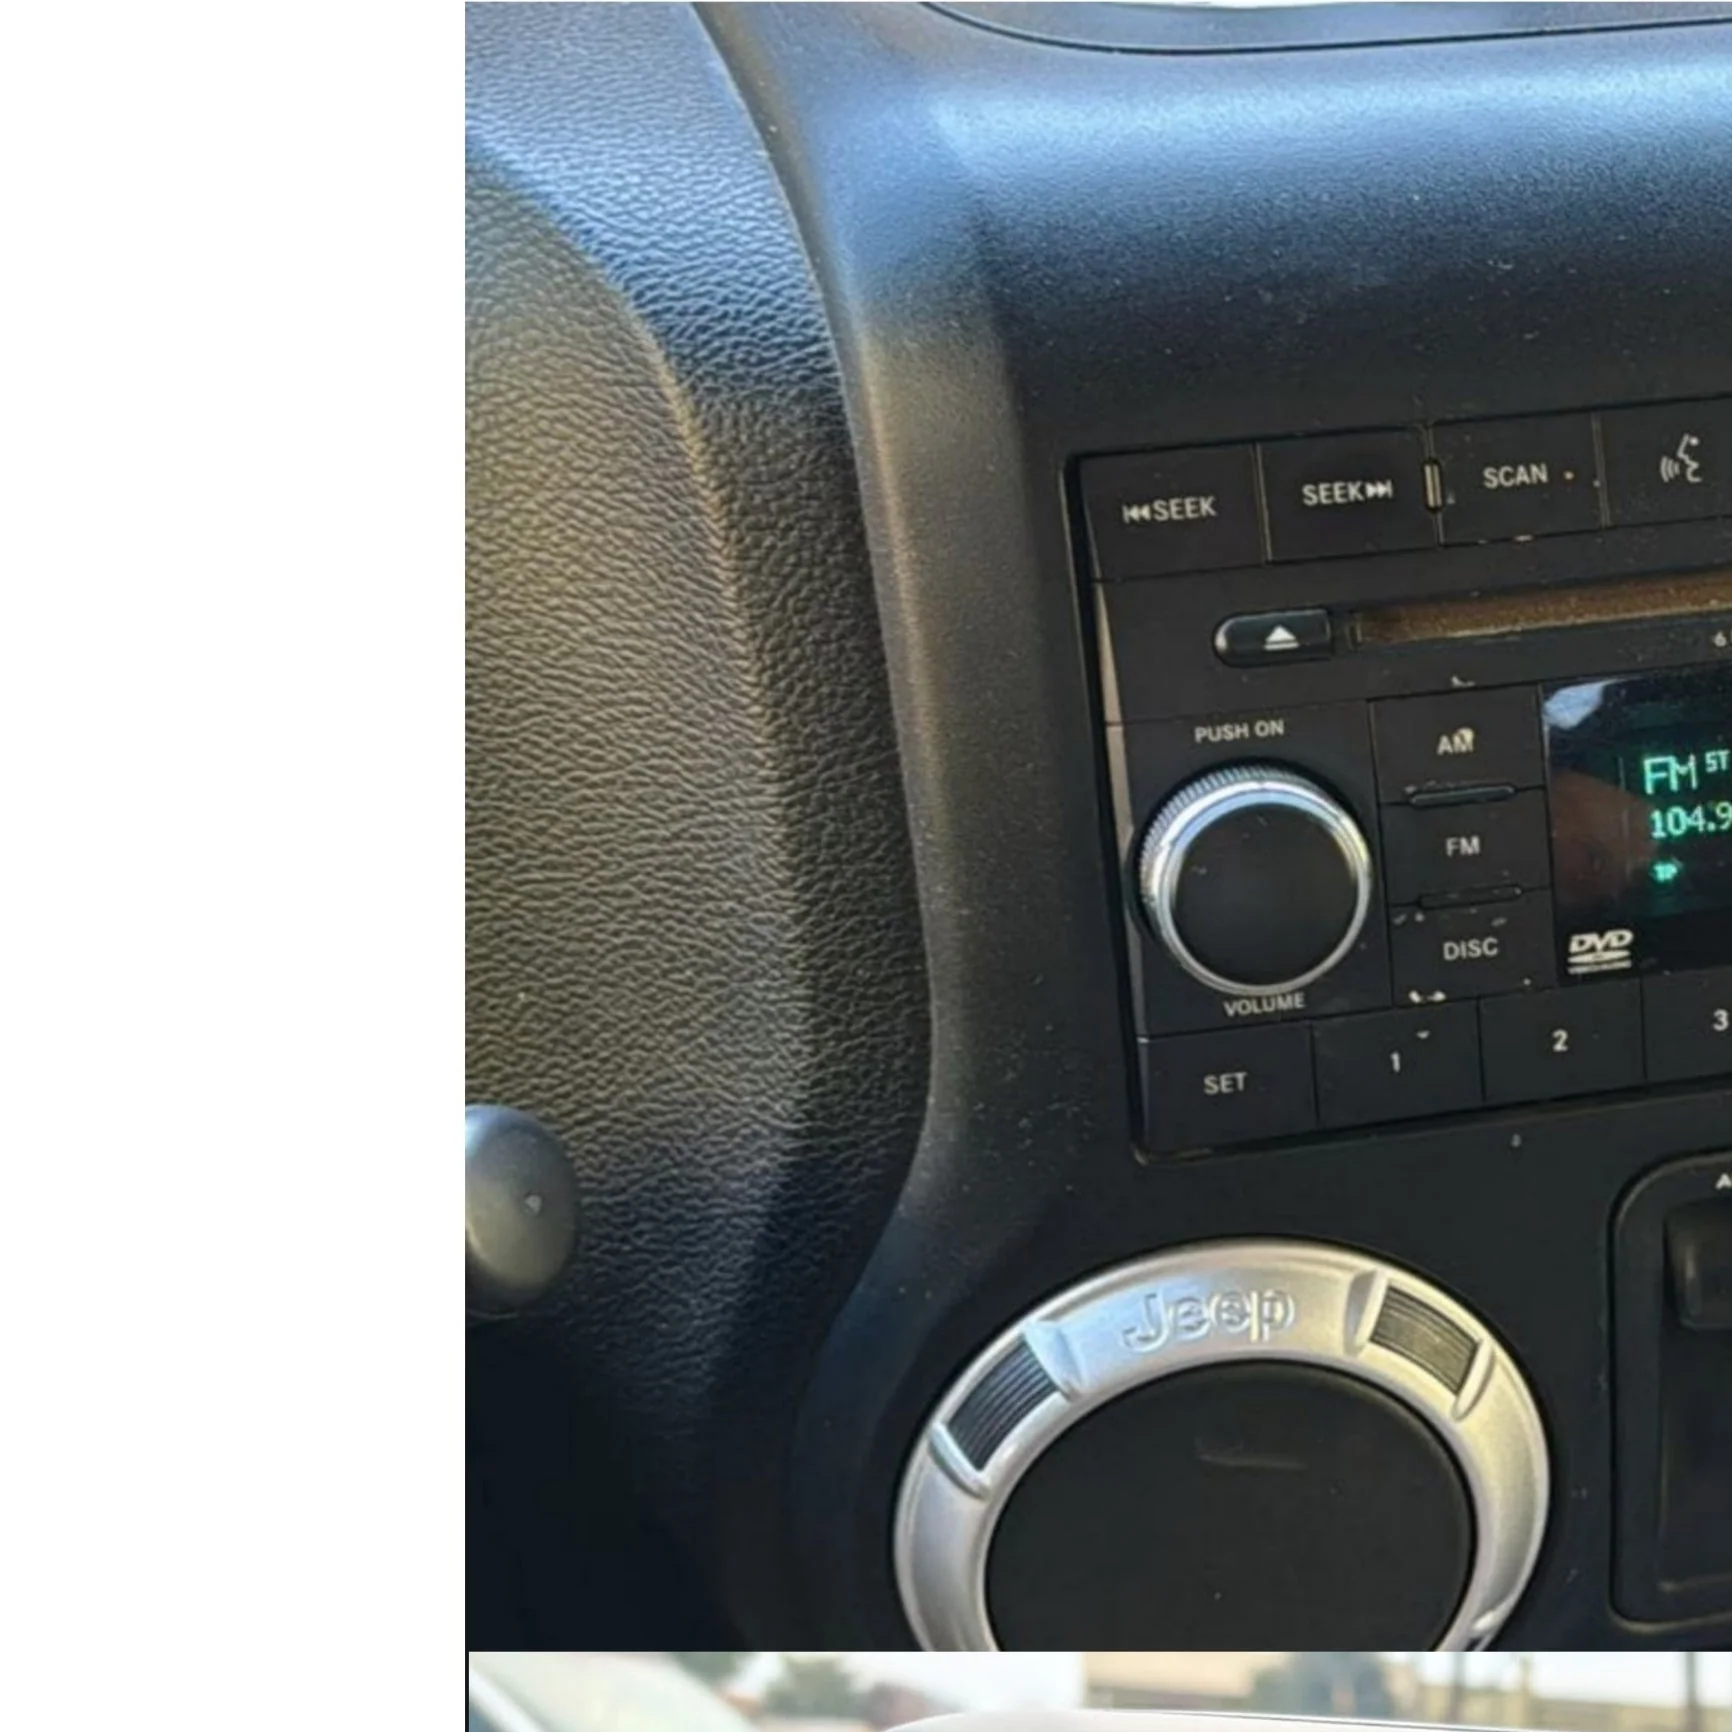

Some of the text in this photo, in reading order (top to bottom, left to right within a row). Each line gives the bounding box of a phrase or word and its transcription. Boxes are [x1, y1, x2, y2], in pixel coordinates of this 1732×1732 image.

[1483, 464, 1548, 489] SCAN
[1302, 482, 1365, 507] SEEK
[1153, 496, 1217, 522] SEEK
[1714, 628, 1727, 648] 6
[1194, 719, 1285, 743] PUSH ON
[1436, 726, 1475, 756] AM
[1643, 749, 1731, 796] FM ST
[1445, 835, 1481, 857] FM
[1443, 936, 1498, 961] DISC
[1568, 929, 1634, 954] DVD
[1223, 992, 1306, 1017] VOLUME
[1713, 1009, 1729, 1031] 3
[1552, 1029, 1568, 1052] 2
[1390, 1052, 1401, 1072] 1
[1203, 1072, 1248, 1094] SET
[1122, 1289, 1295, 1353] Jeep
